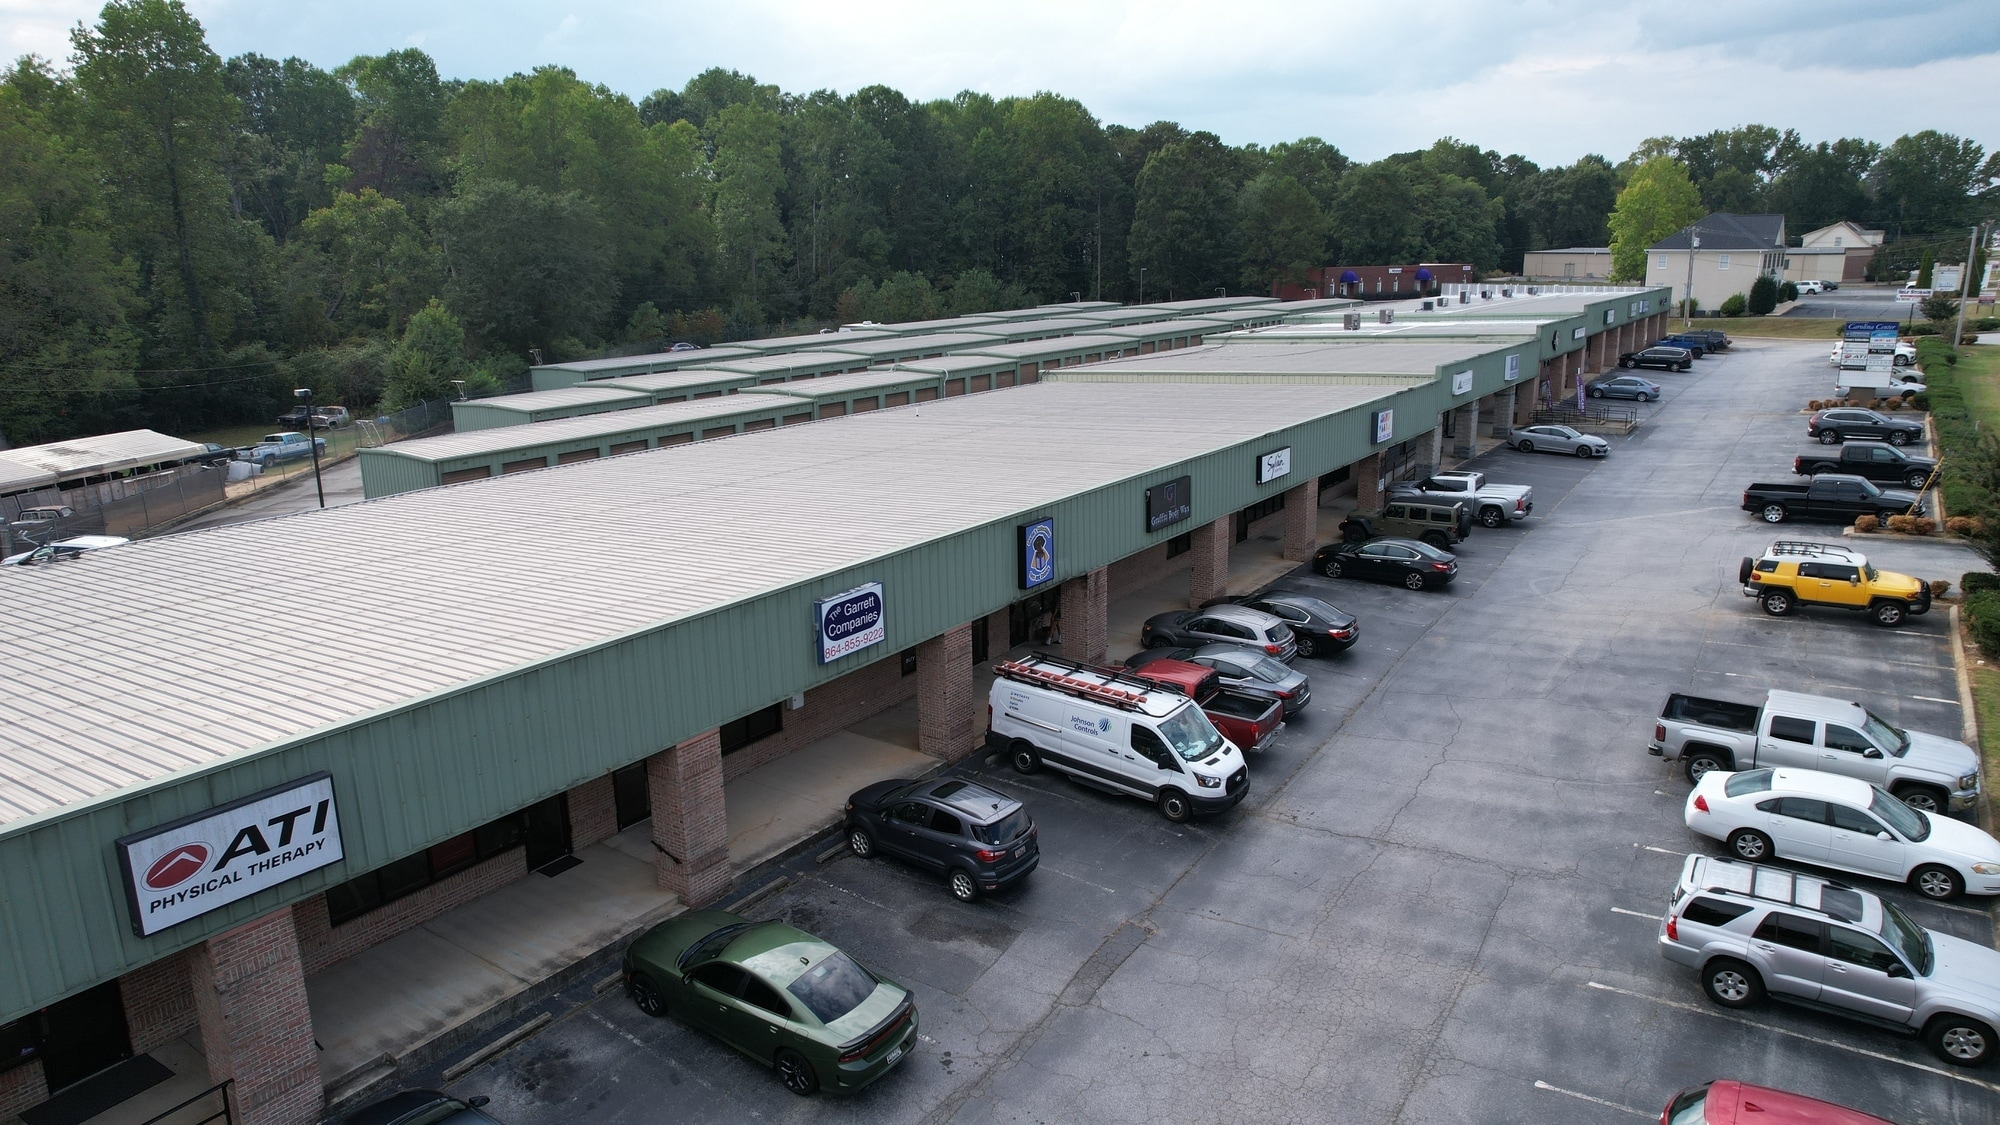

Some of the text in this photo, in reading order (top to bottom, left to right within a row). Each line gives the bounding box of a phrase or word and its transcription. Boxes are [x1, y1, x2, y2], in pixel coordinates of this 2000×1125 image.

[828, 595, 875, 621] The Garrett
[828, 610, 879, 637] Companies
[825, 627, 884, 659] 864-855-9222
[1070, 715, 1095, 728] Johnson
[1074, 723, 1099, 736] Controls
[212, 798, 330, 873] ATI
[150, 837, 326, 914] PHYSICAL THERAPY
